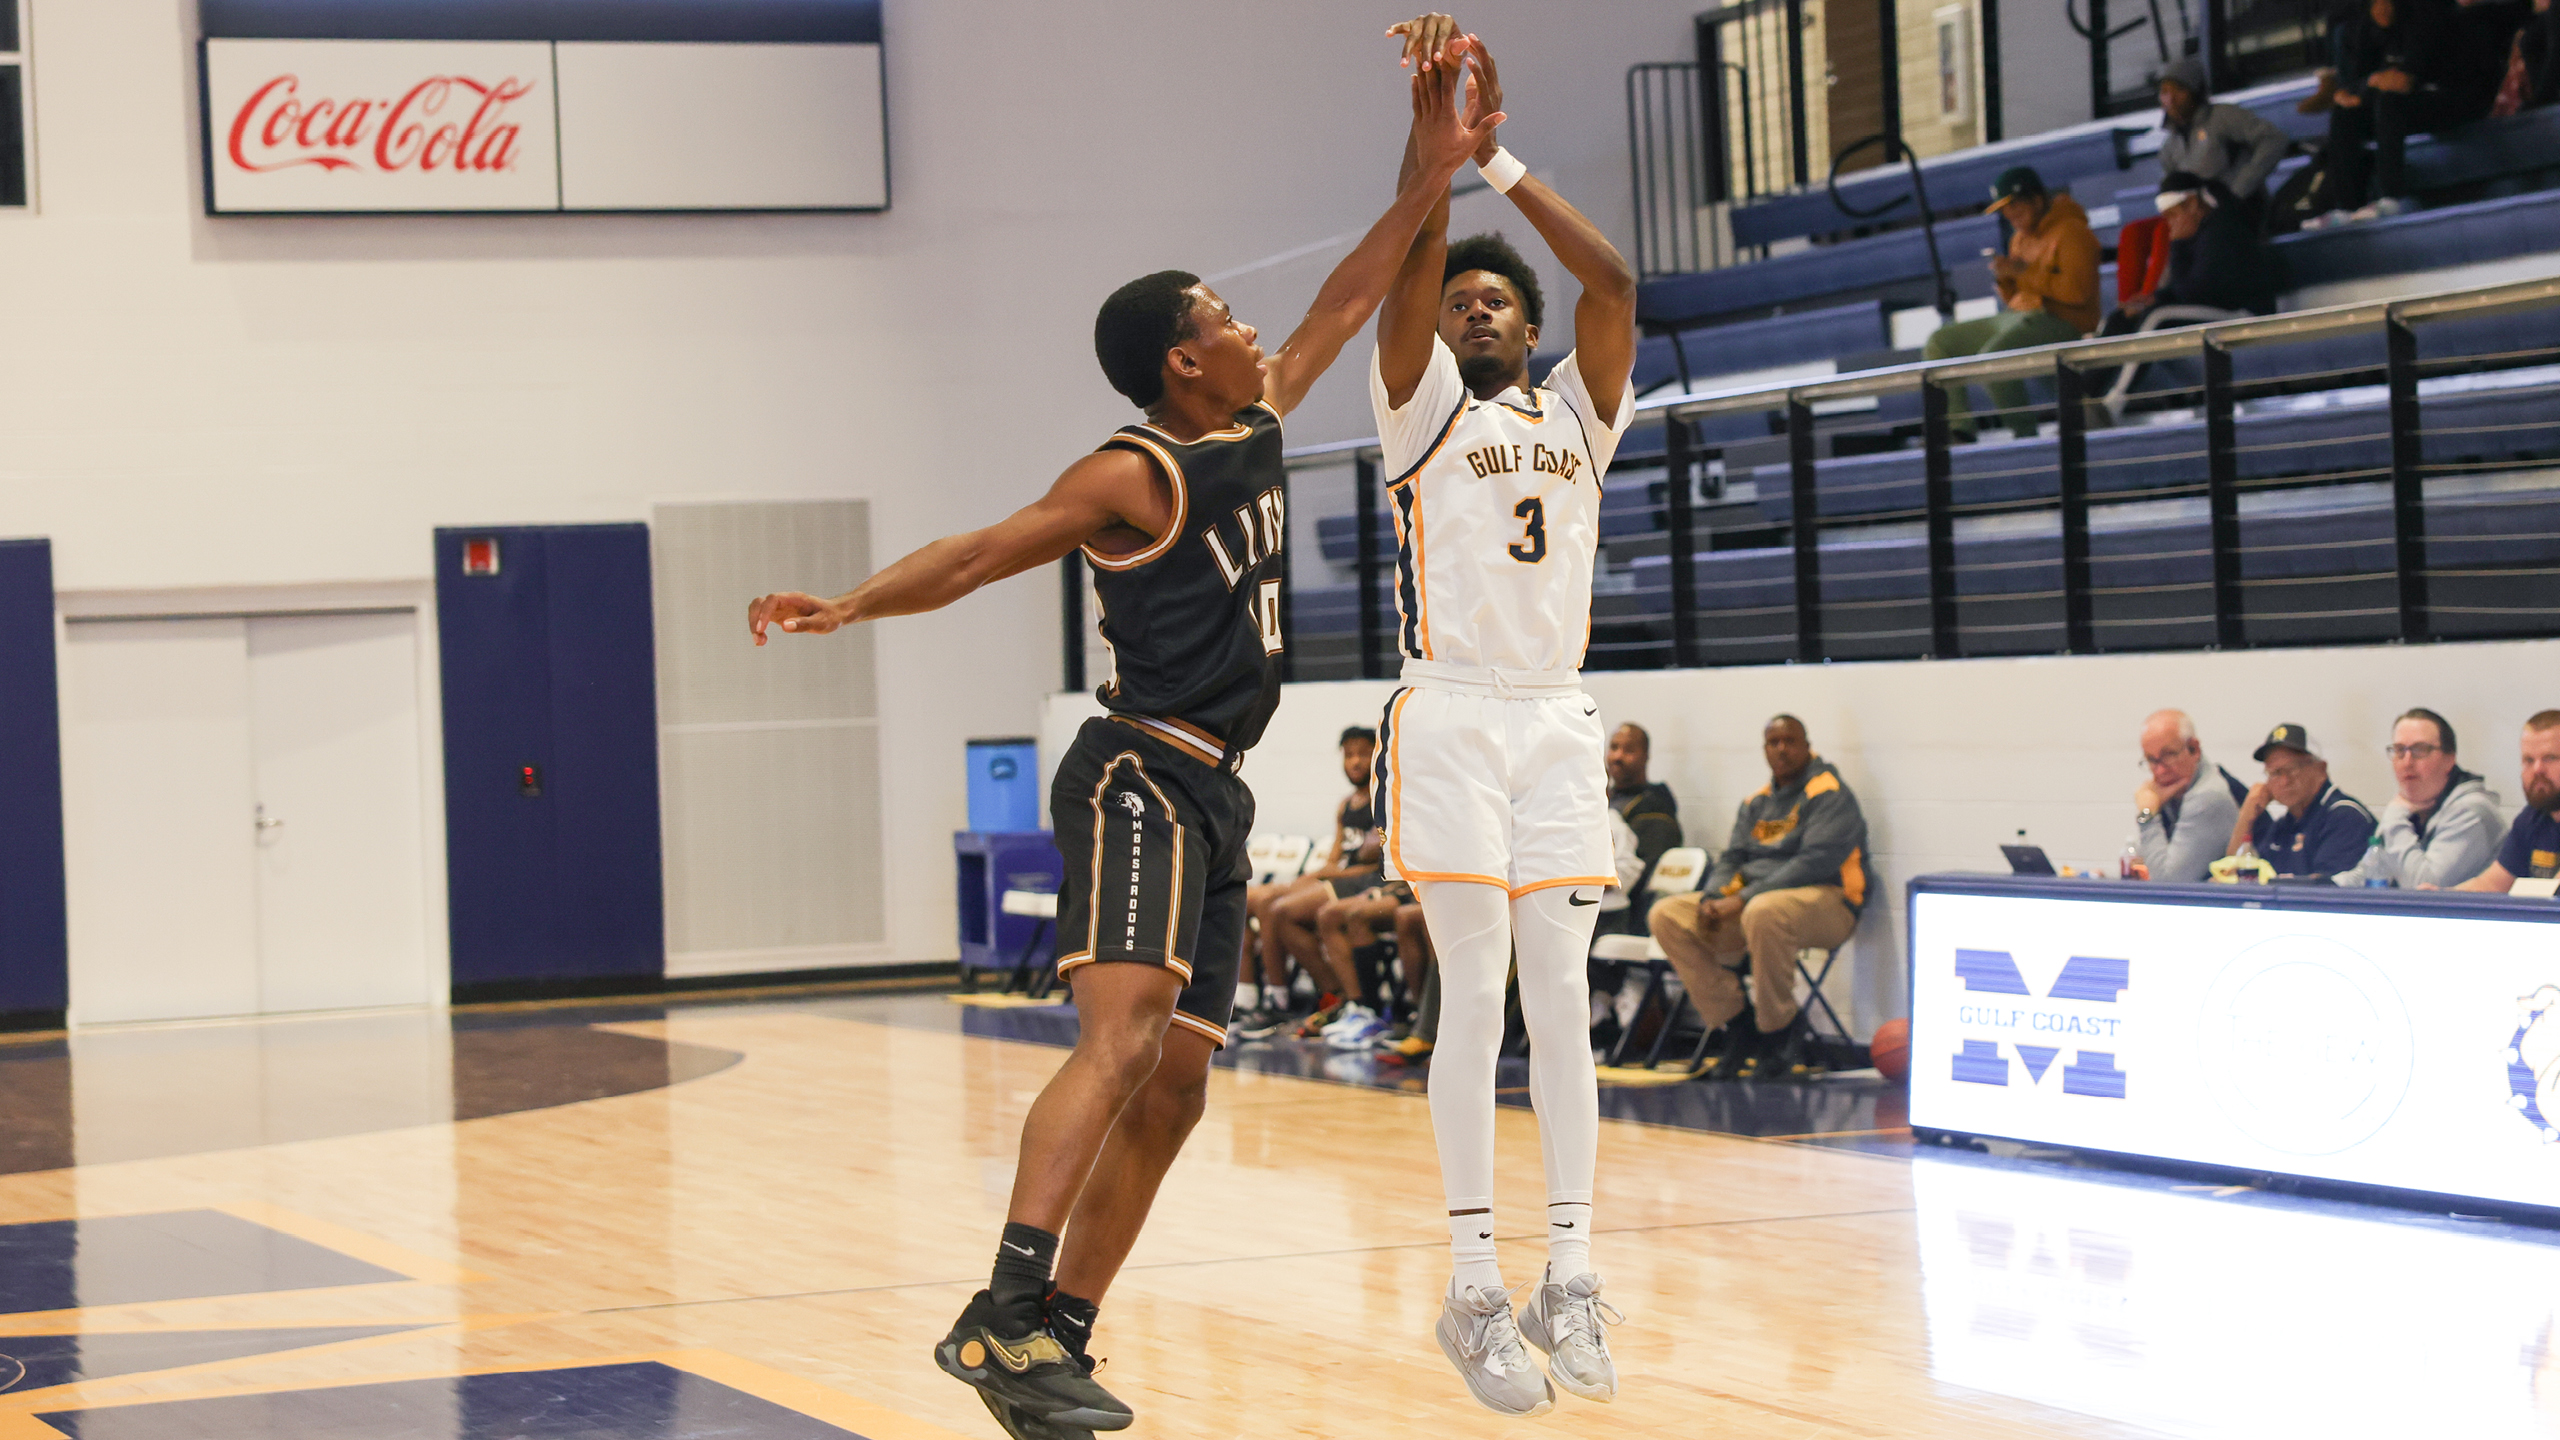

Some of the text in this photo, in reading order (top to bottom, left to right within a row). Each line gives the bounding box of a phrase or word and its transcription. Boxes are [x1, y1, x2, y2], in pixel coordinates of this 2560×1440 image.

[1466, 444, 1522, 479] GULF
[1507, 495, 1547, 565] 3
[1126, 807, 1143, 951] AMBASSADORS
[1959, 1005, 2122, 1037] GULF COAST
